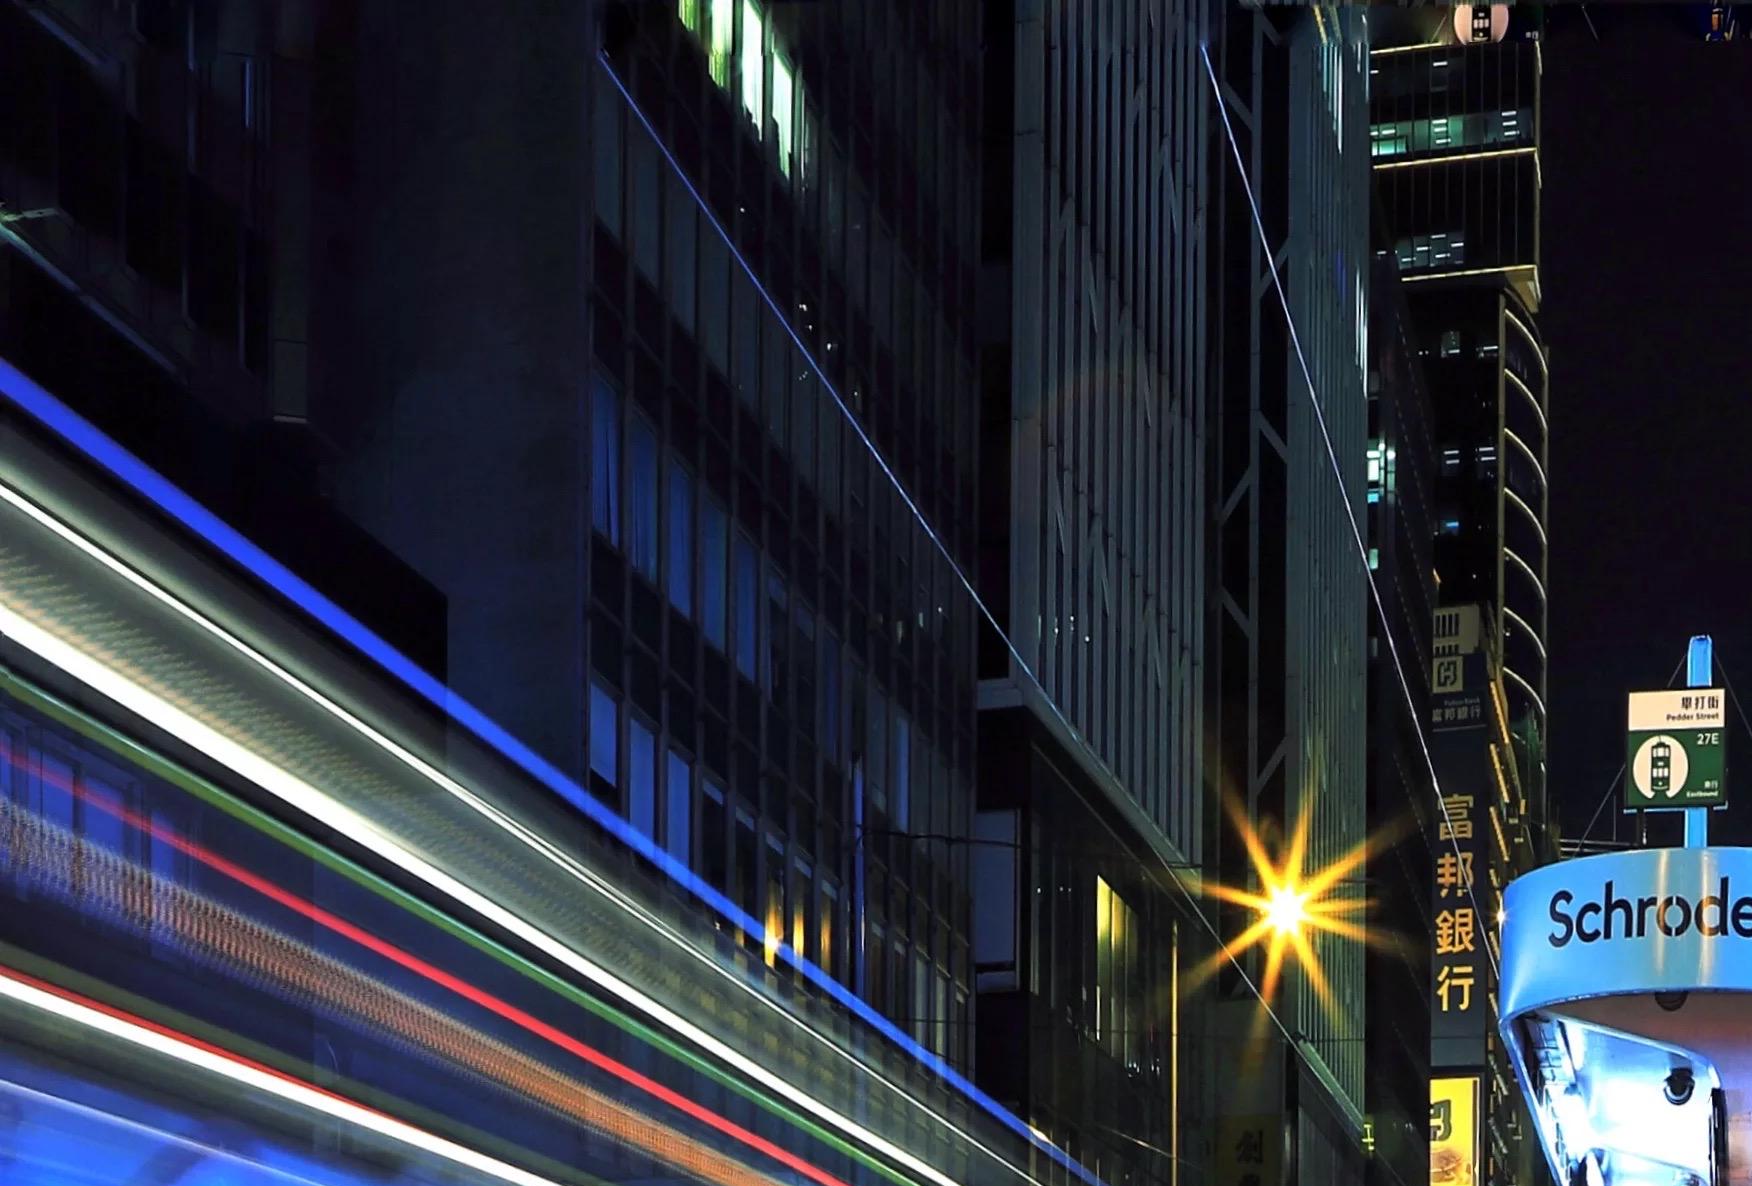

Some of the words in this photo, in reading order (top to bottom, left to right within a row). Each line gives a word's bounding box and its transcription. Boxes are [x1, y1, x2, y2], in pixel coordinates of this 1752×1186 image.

[1666, 713, 1694, 722] Pedder
[1696, 712, 1719, 720] Street
[1697, 733, 1719, 745] 27E
[1435, 794, 1475, 1012] 富邦銀行
